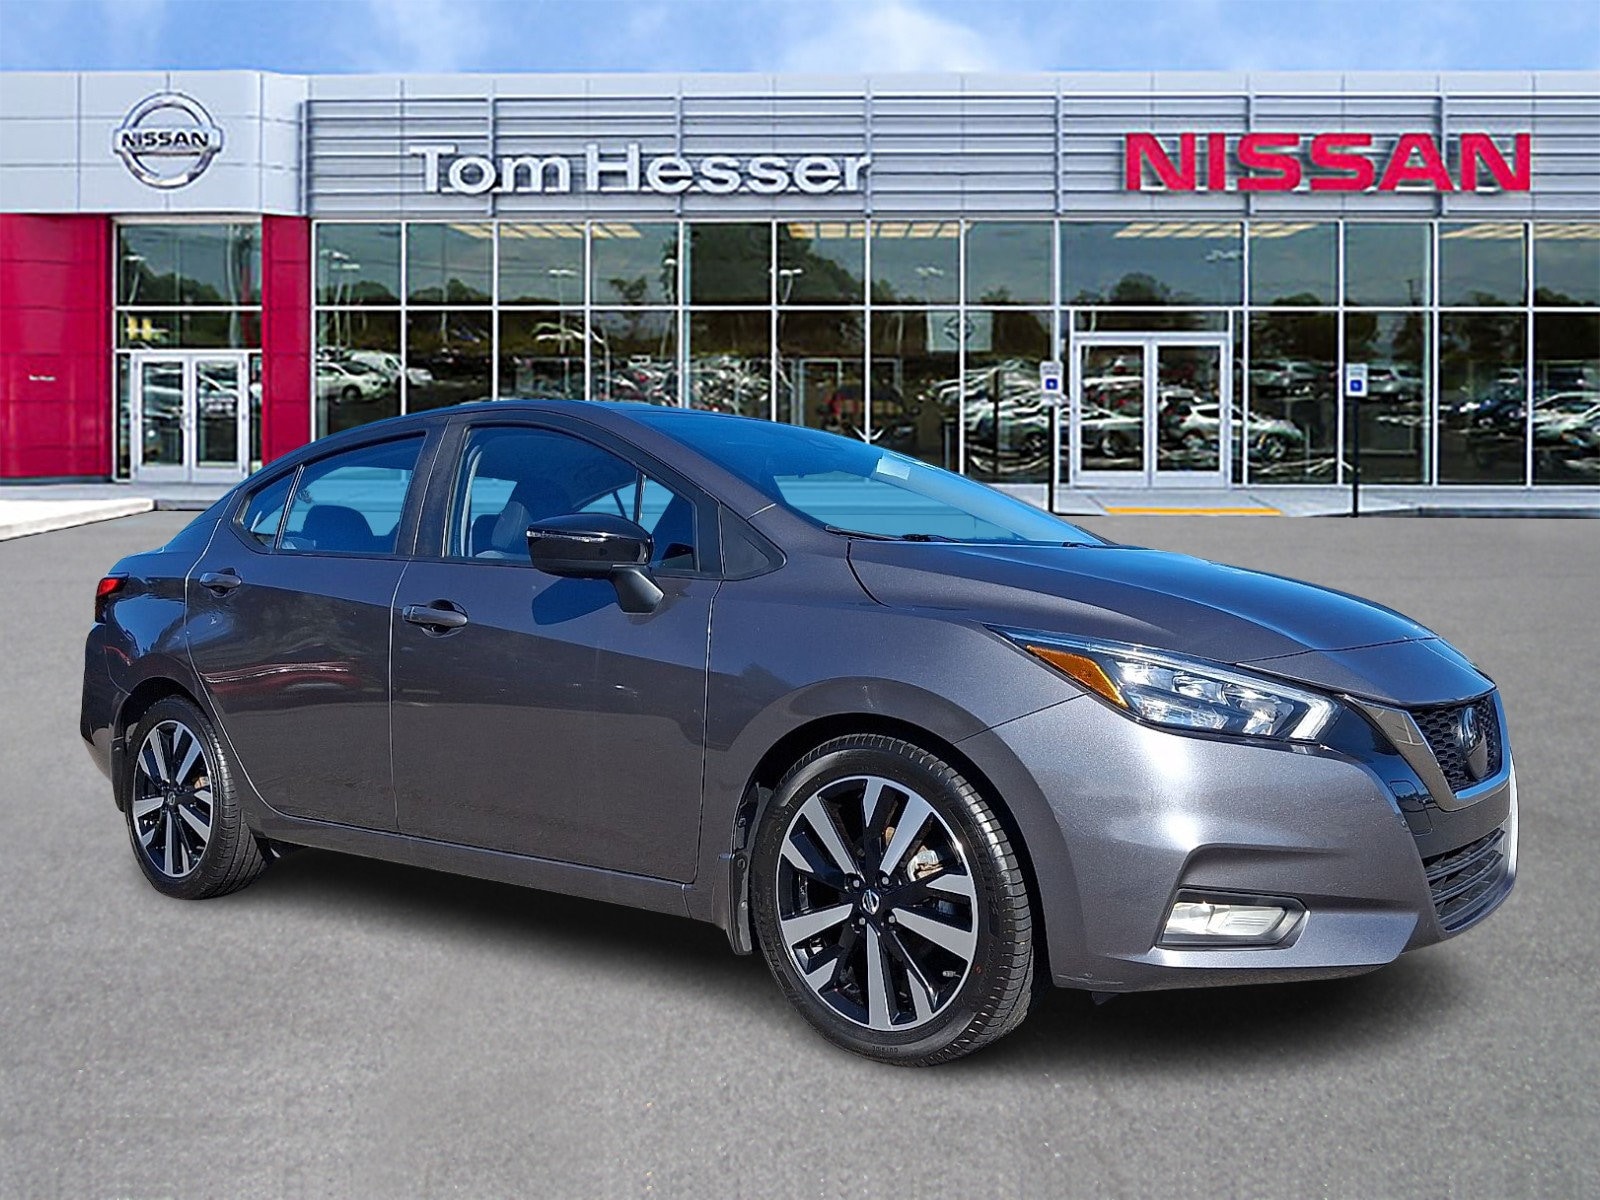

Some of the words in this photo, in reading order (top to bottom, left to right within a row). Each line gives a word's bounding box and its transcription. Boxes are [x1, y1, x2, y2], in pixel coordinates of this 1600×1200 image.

[122, 131, 208, 147] NISSAN
[1125, 132, 1531, 191] NISSAN
[409, 143, 571, 194] Tom
[586, 143, 871, 194] Hesser
